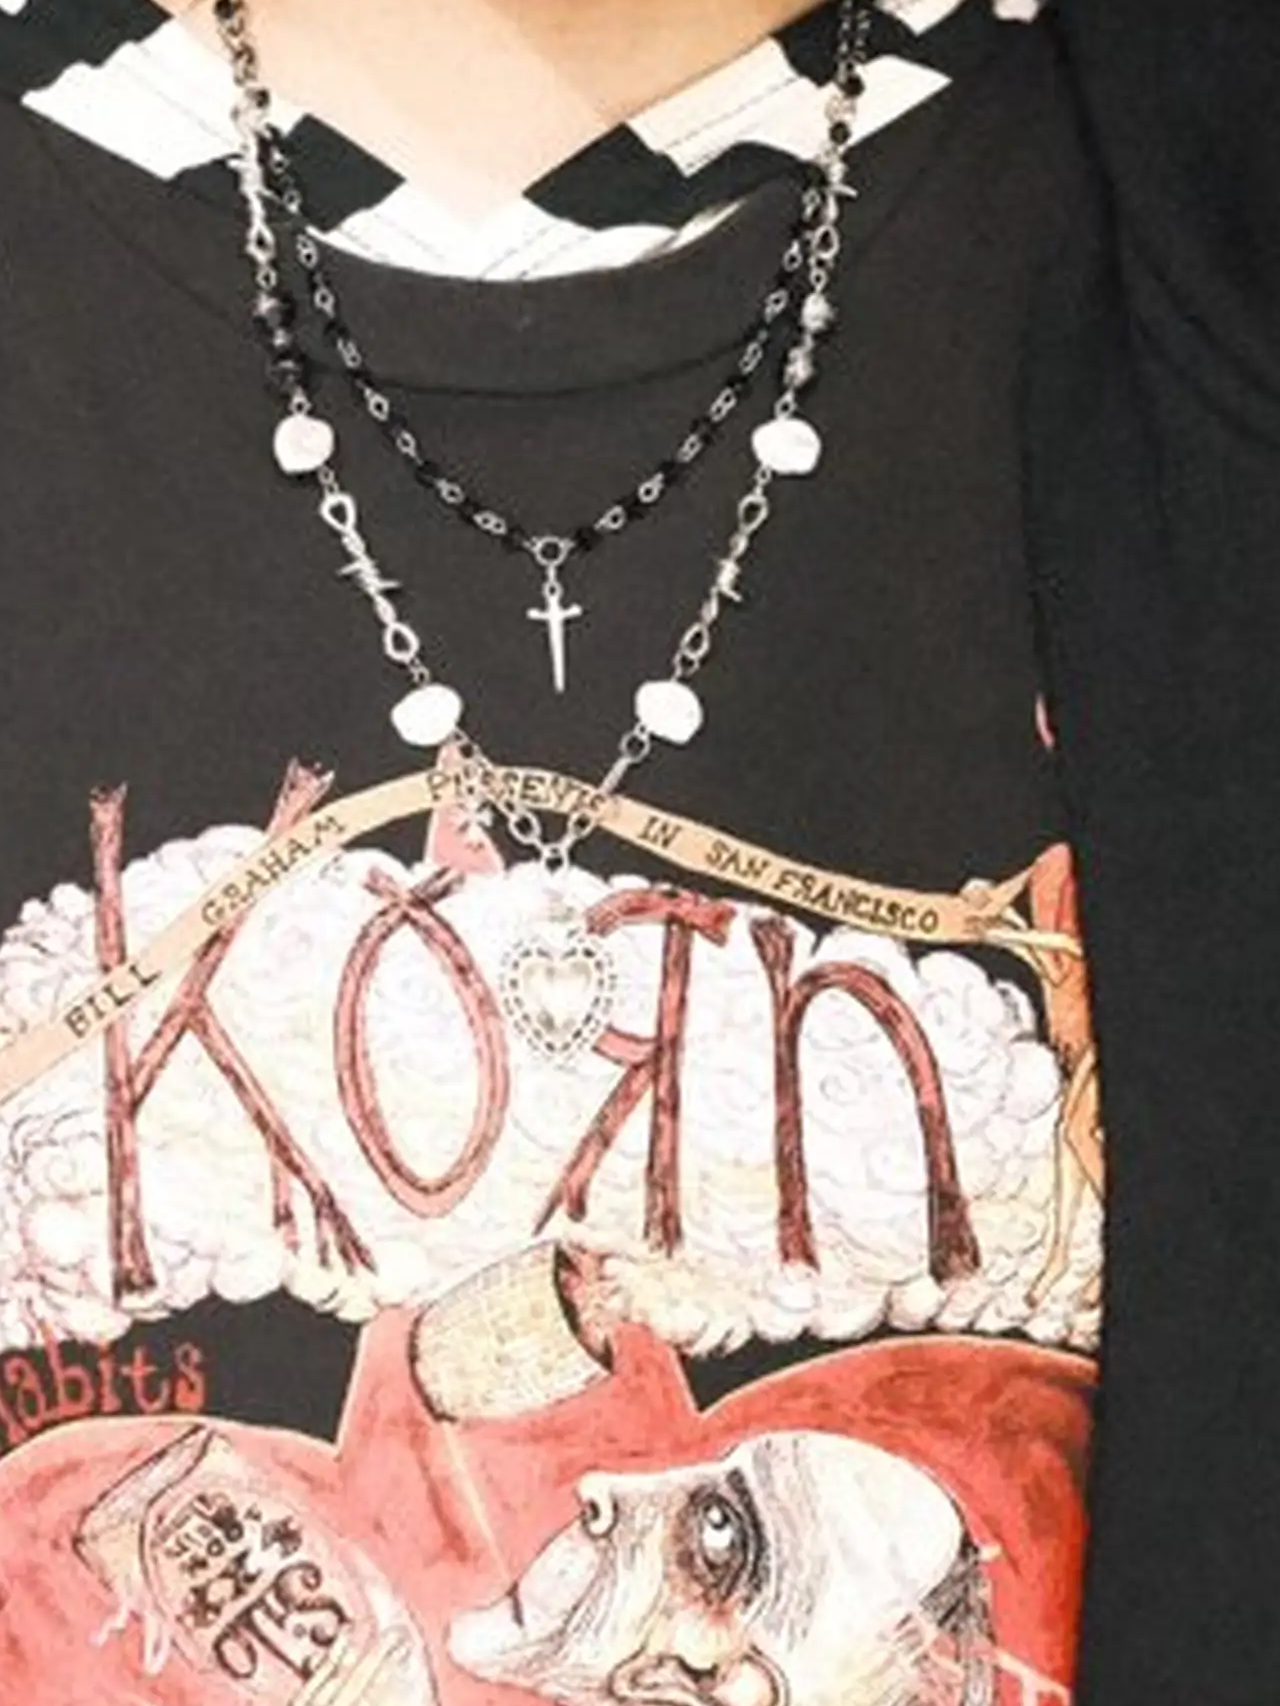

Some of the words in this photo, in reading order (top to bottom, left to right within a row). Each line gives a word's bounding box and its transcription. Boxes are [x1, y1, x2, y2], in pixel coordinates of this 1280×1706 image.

[64, 964, 161, 1039] BILL
[201, 814, 348, 927] GRAHAM
[427, 771, 607, 813] PSENTS
[636, 812, 679, 848] IN
[705, 839, 770, 888] SAN
[774, 869, 941, 936] FRANCISCO
